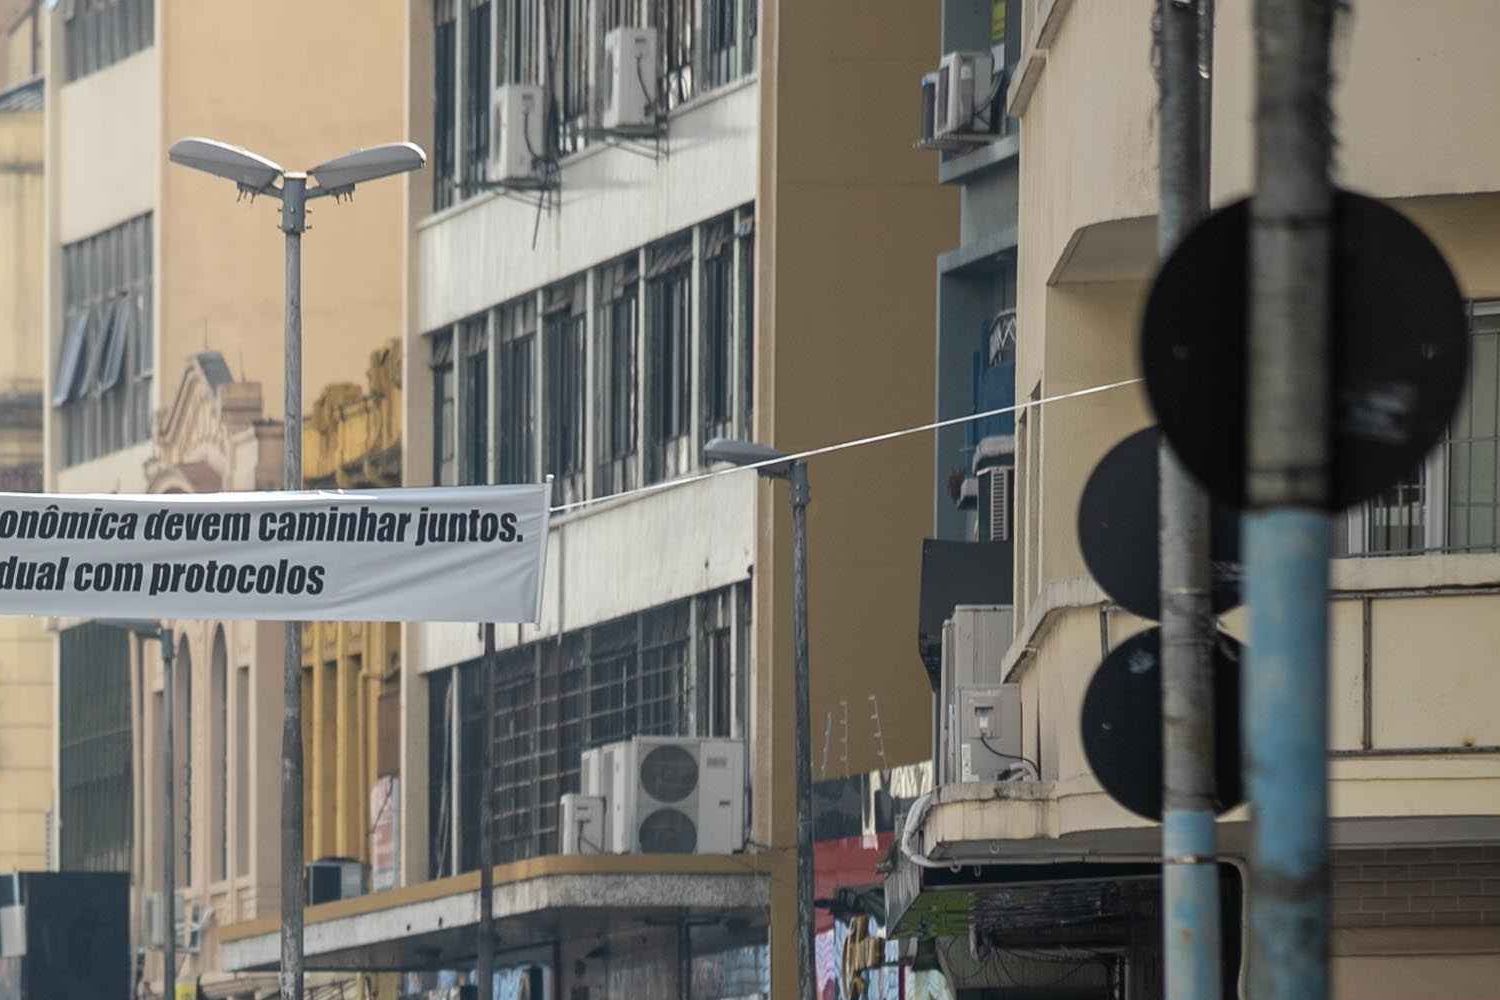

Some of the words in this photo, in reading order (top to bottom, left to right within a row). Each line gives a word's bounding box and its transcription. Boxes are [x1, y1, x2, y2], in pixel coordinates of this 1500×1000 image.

[143, 508, 252, 542] devem
[258, 505, 412, 543] caminhar
[414, 506, 524, 547] juntos.
[73, 562, 144, 592] com
[148, 558, 326, 596] protocolos
